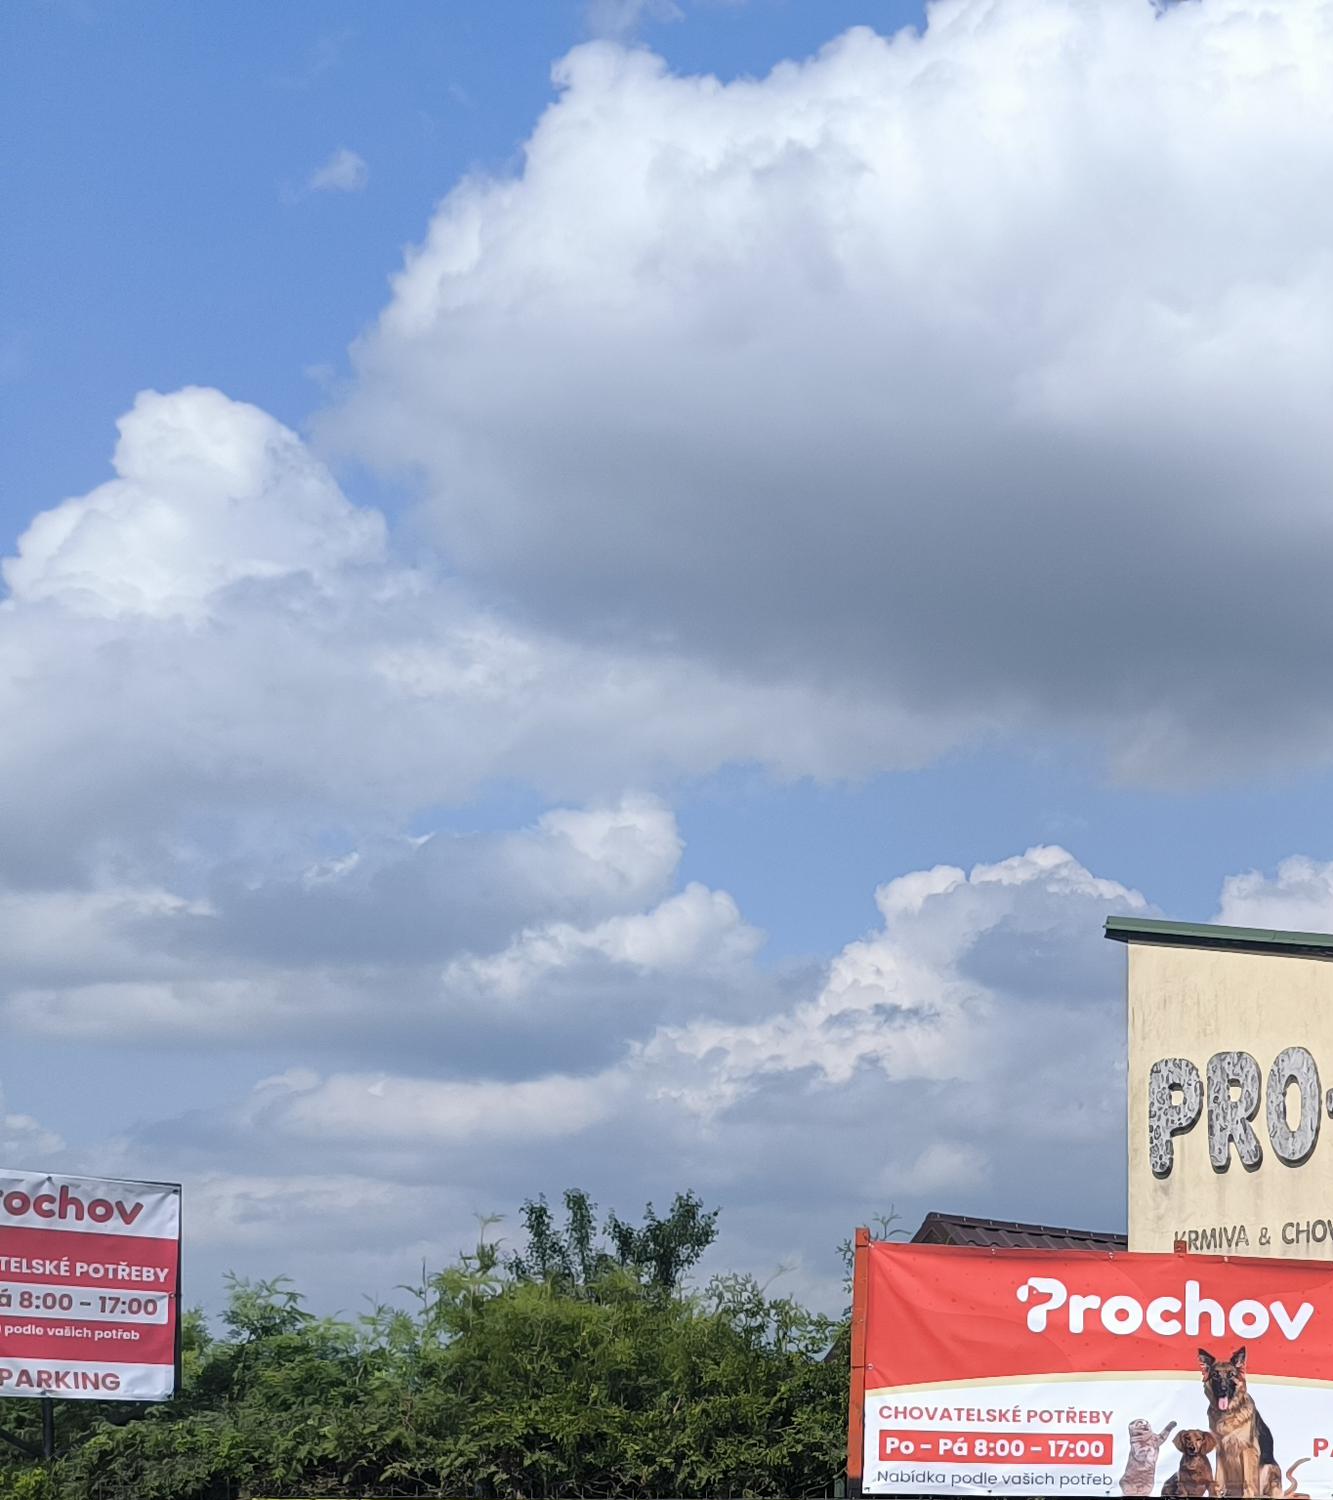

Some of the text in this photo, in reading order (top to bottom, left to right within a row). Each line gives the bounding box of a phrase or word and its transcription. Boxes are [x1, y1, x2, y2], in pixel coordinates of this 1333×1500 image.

[0, 1185, 144, 1225] ochov
[1174, 1224, 1250, 1252] KRMIVA
[1258, 1227, 1272, 1247] &
[75, 1261, 169, 1283] POTŘEBY
[19, 1291, 73, 1311] 8:00
[98, 1296, 158, 1316] 17:00
[1016, 1277, 1314, 1340] Prochov
[4, 1323, 140, 1341] podle vašich potřeb
[0, 1368, 121, 1391] PARKING
[879, 1405, 1113, 1424] CHOVATELSKÉ POTŘEBY
[885, 1437, 914, 1455] Po
[938, 1437, 967, 1456] Pá
[974, 1439, 1024, 1457] 8:00
[1048, 1440, 1104, 1458] 17:00
[877, 1470, 1113, 1488] Nabídka podle vašich potřeb
